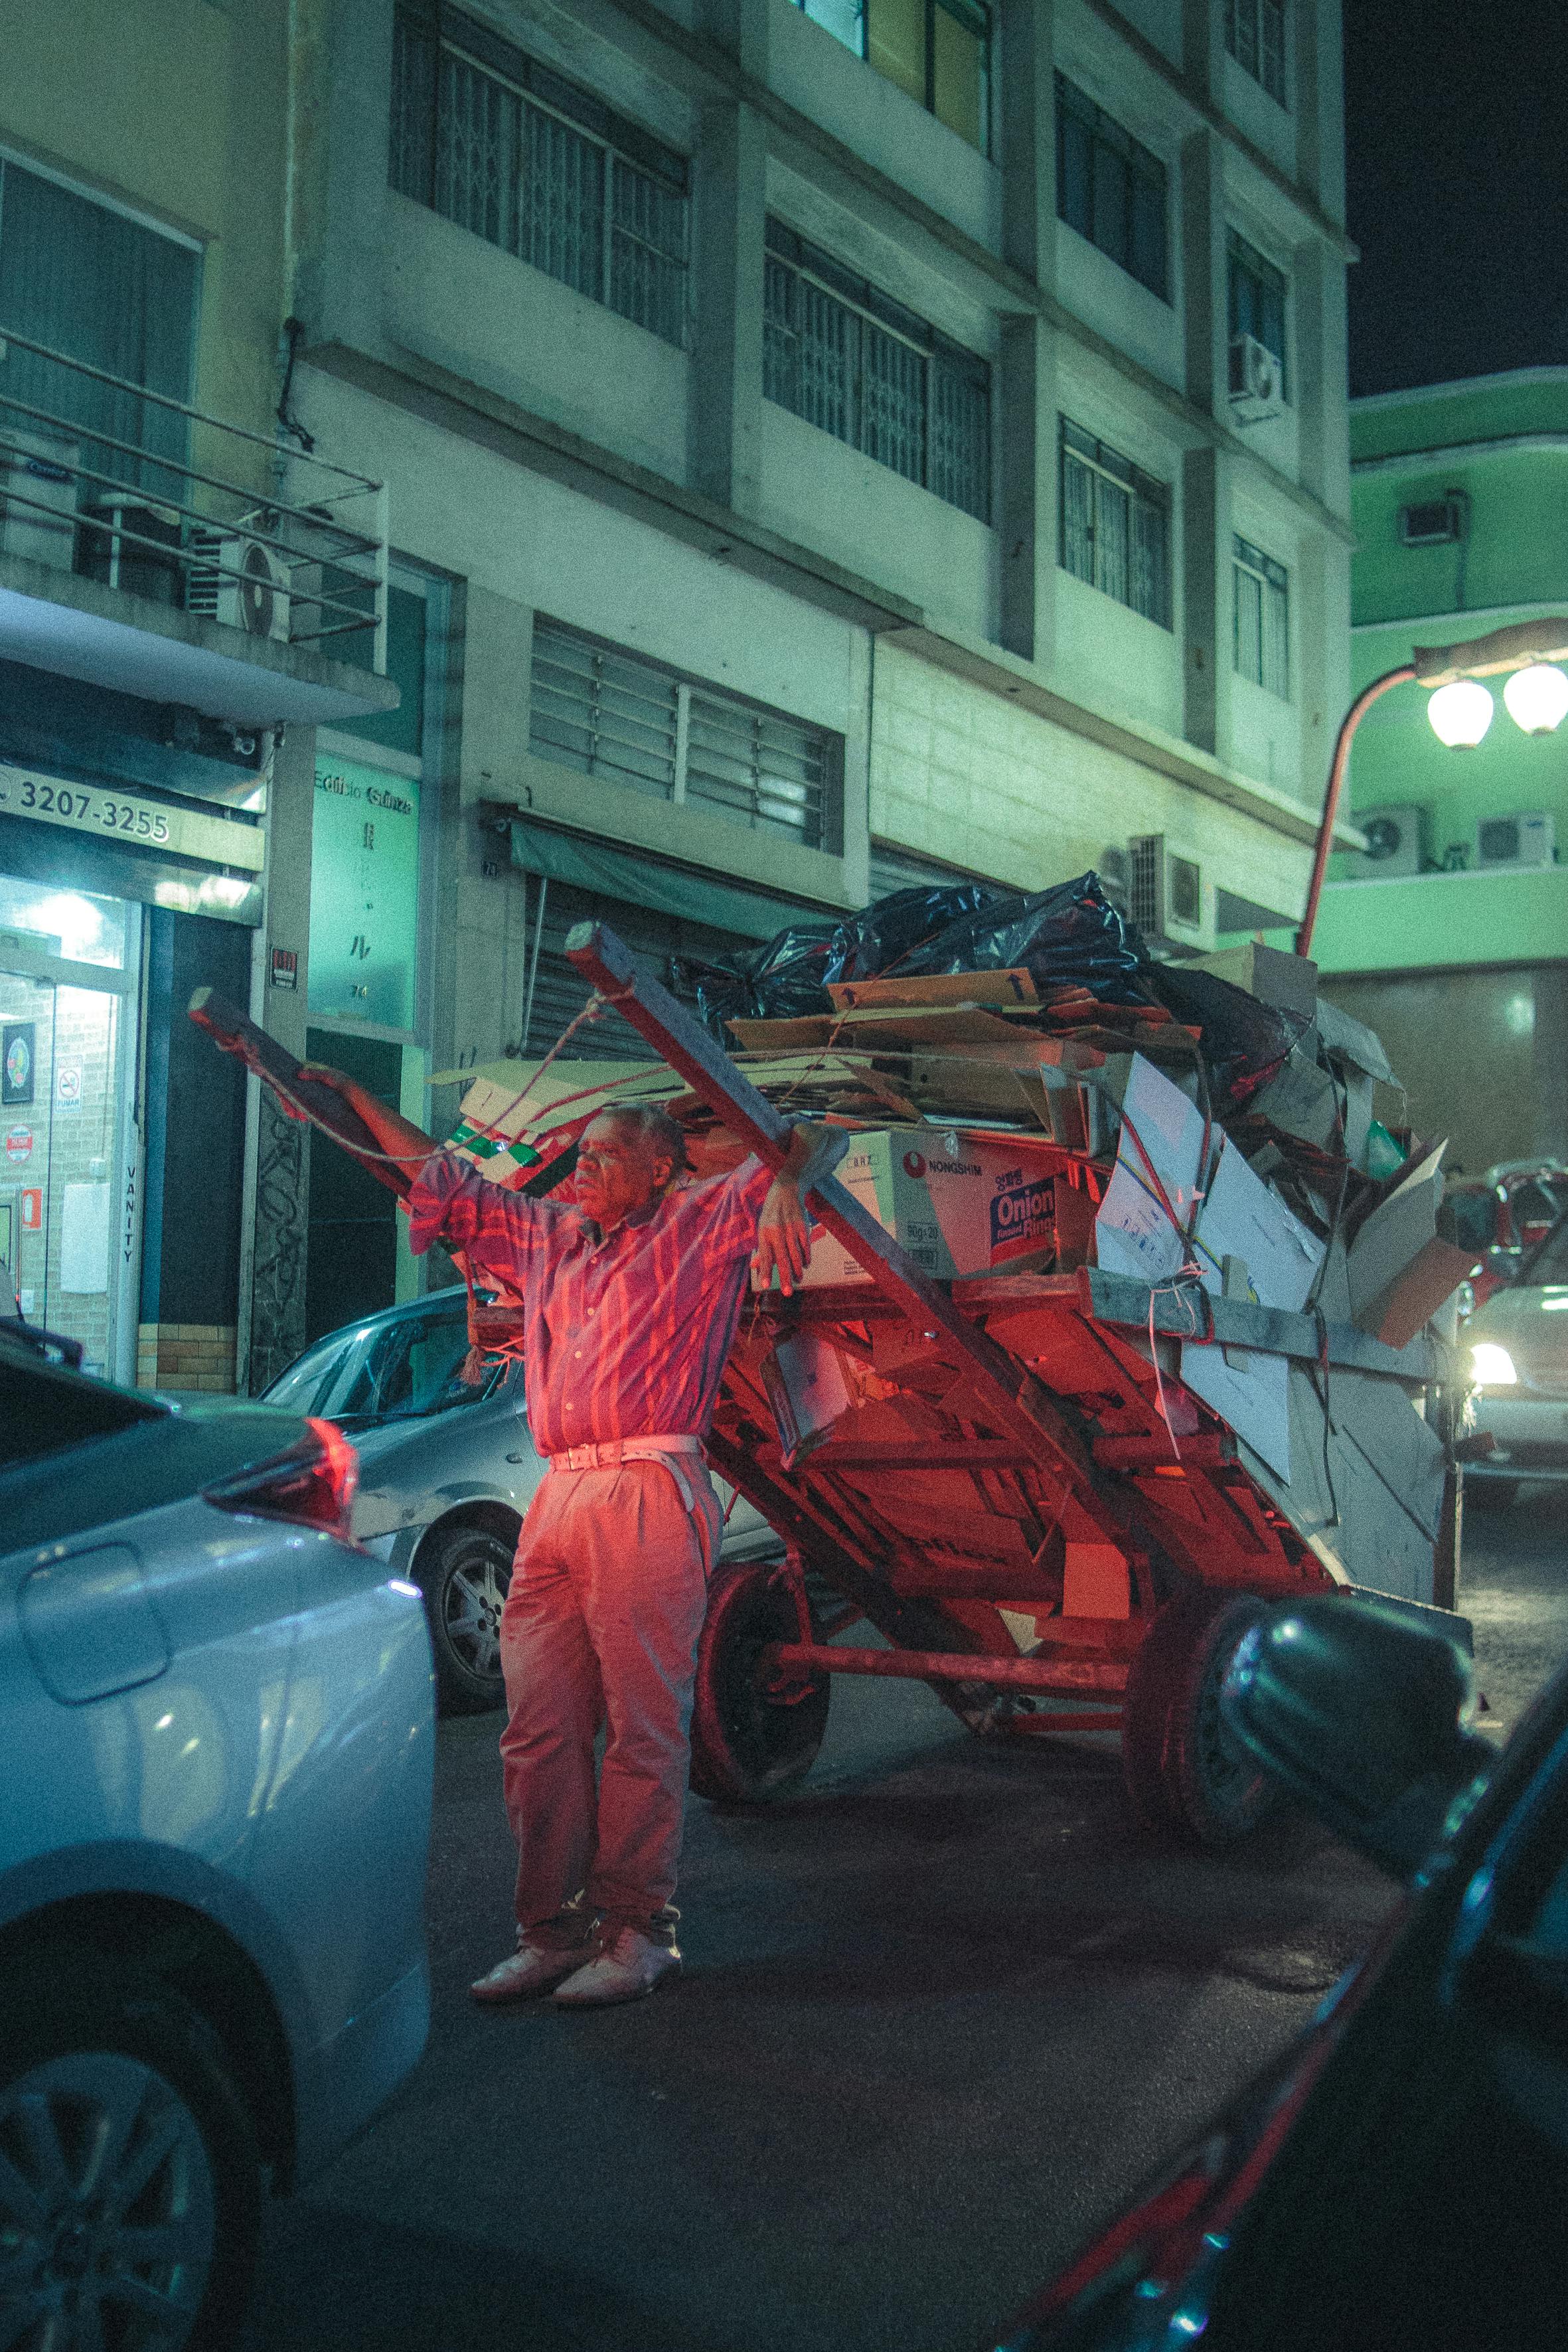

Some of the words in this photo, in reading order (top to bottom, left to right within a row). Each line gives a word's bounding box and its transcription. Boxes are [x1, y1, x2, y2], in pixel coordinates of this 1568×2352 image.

[21, 781, 167, 840] 3207-3255
[929, 1160, 982, 1176] NONGSHIM
[124, 1166, 135, 1263] VANITY
[997, 1189, 1054, 1226] Onion
